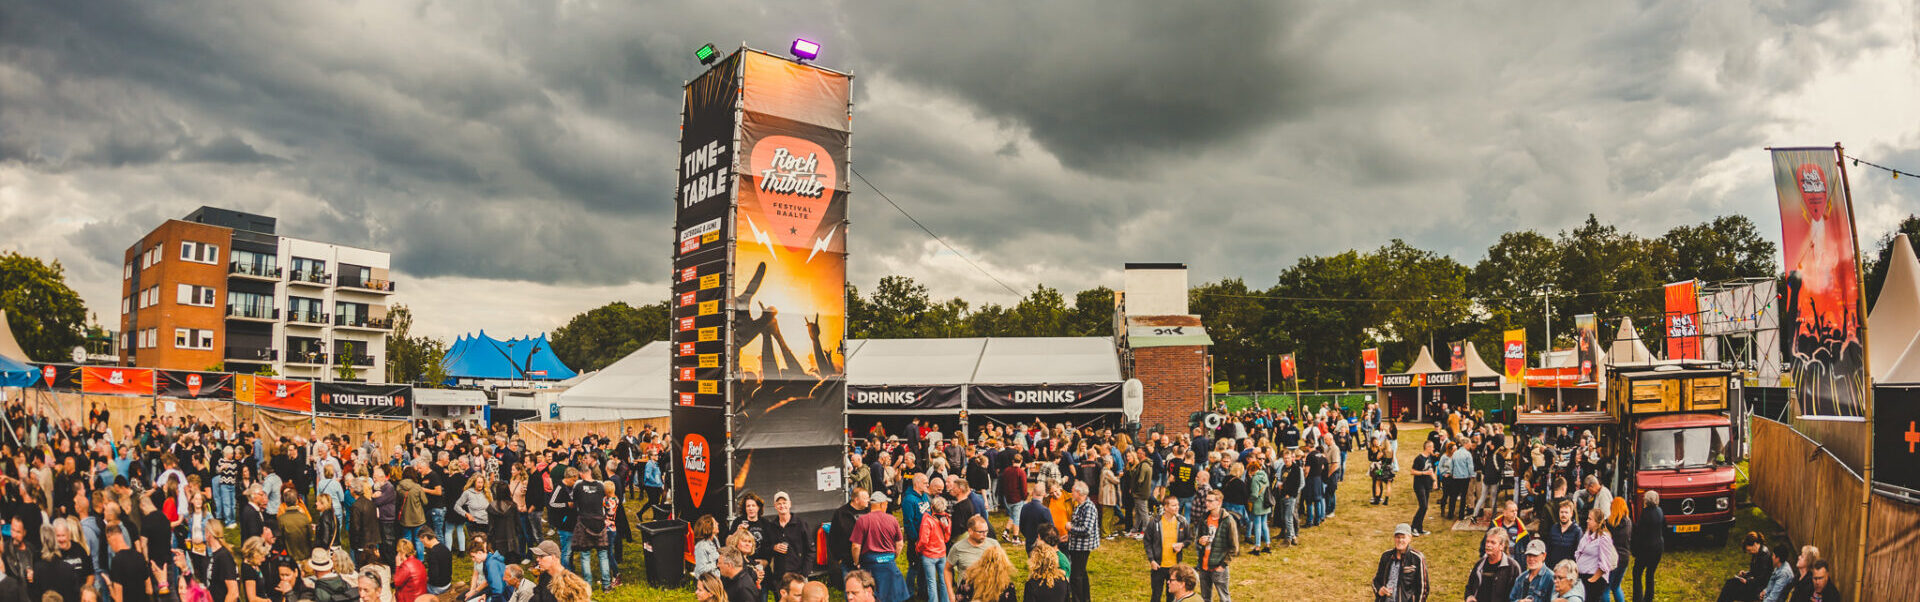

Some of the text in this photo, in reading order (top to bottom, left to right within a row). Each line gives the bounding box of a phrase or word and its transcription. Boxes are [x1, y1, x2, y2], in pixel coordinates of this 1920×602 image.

[684, 140, 726, 179] TIME-
[770, 147, 818, 173] Rock
[683, 167, 728, 209] TABLE
[760, 168, 826, 199] Tribute
[773, 202, 812, 213] FESTIVAL
[1383, 375, 1411, 385] LOCKERS
[332, 393, 394, 406] TOILETTEN
[857, 391, 915, 404] DRINKS
[1015, 390, 1076, 404] DRINKS
